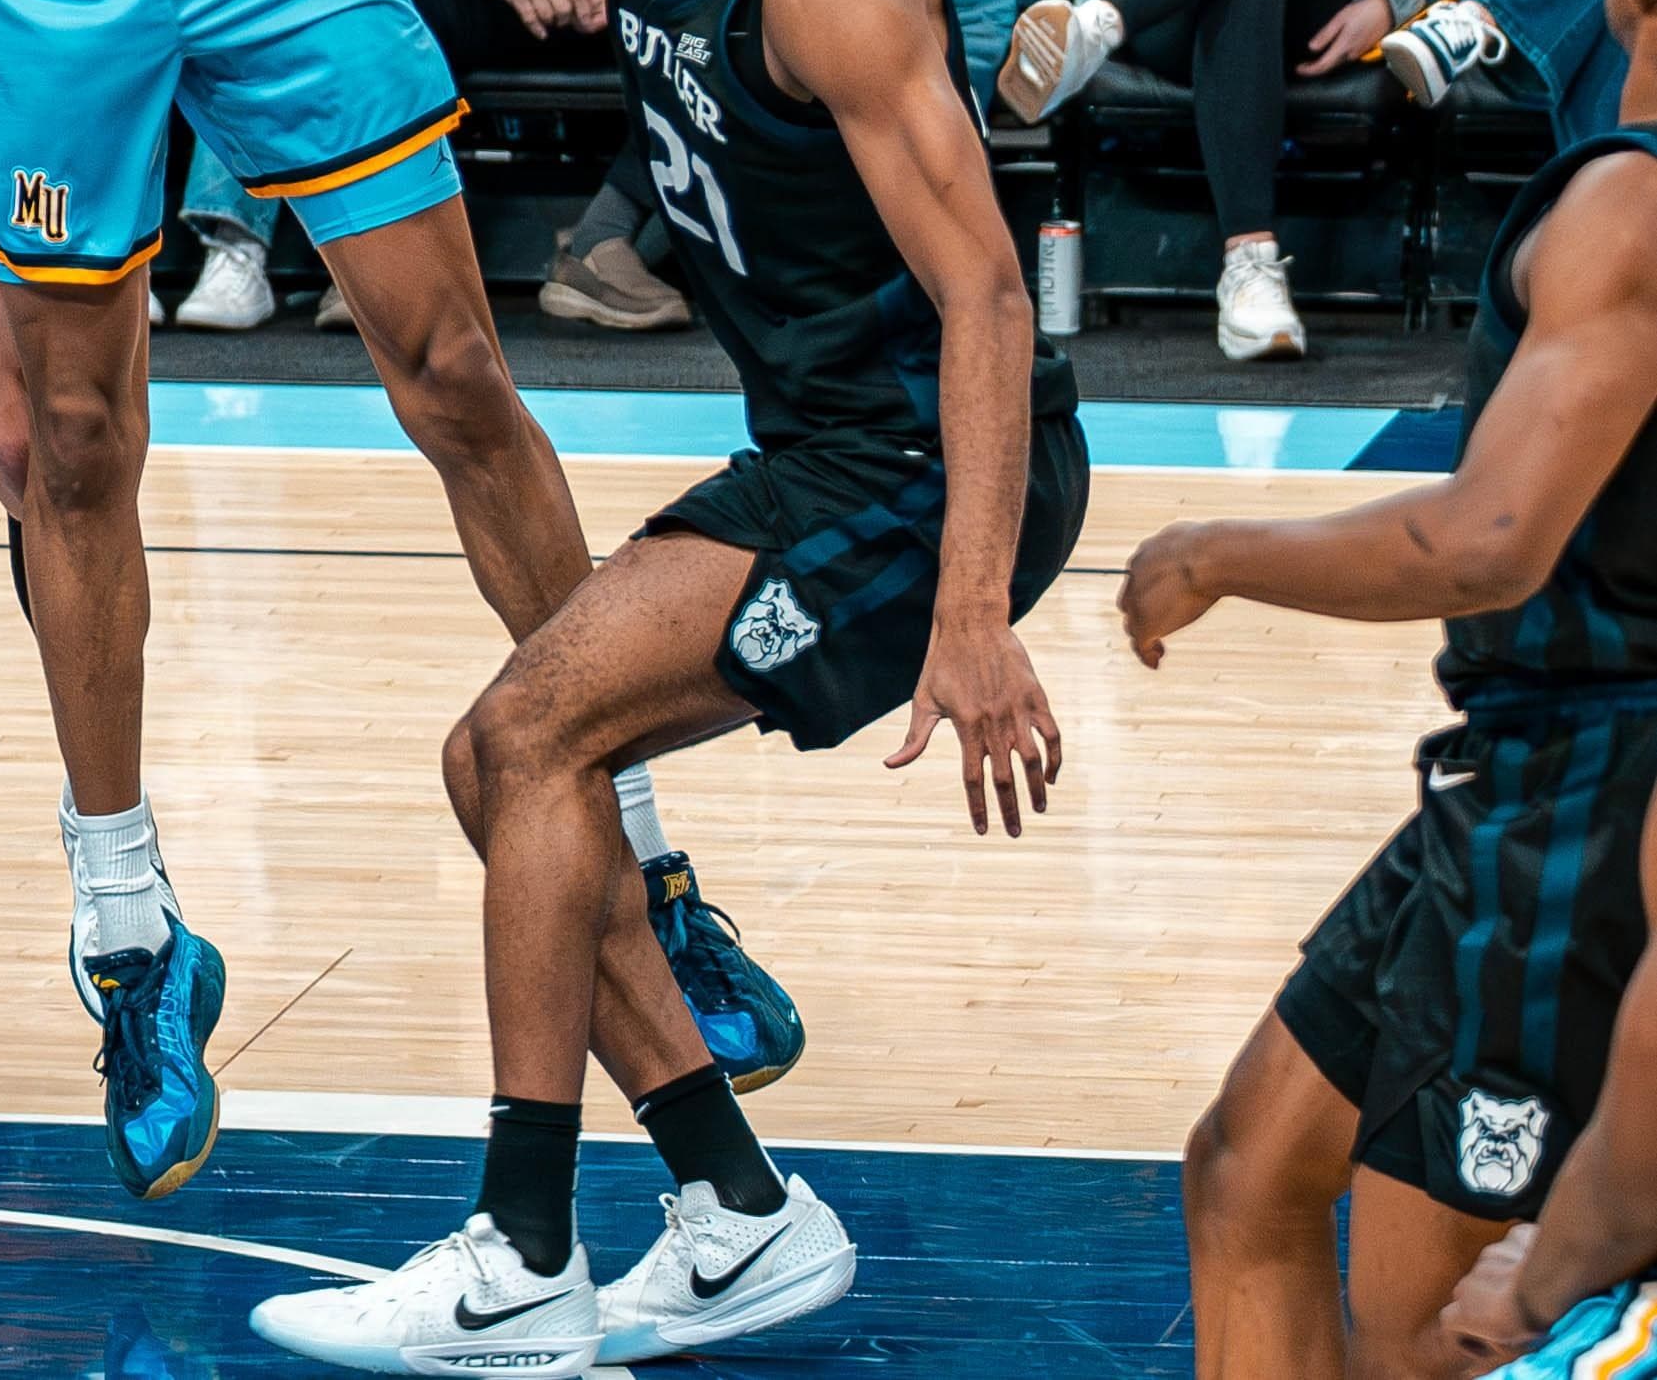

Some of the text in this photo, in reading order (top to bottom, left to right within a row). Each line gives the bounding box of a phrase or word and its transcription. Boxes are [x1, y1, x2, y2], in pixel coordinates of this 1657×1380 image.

[618, 7, 728, 144] BUTLER
[676, 42, 713, 64] EAST
[679, 32, 707, 51] BIG
[11, 169, 70, 243] MU
[642, 100, 749, 277] 21
